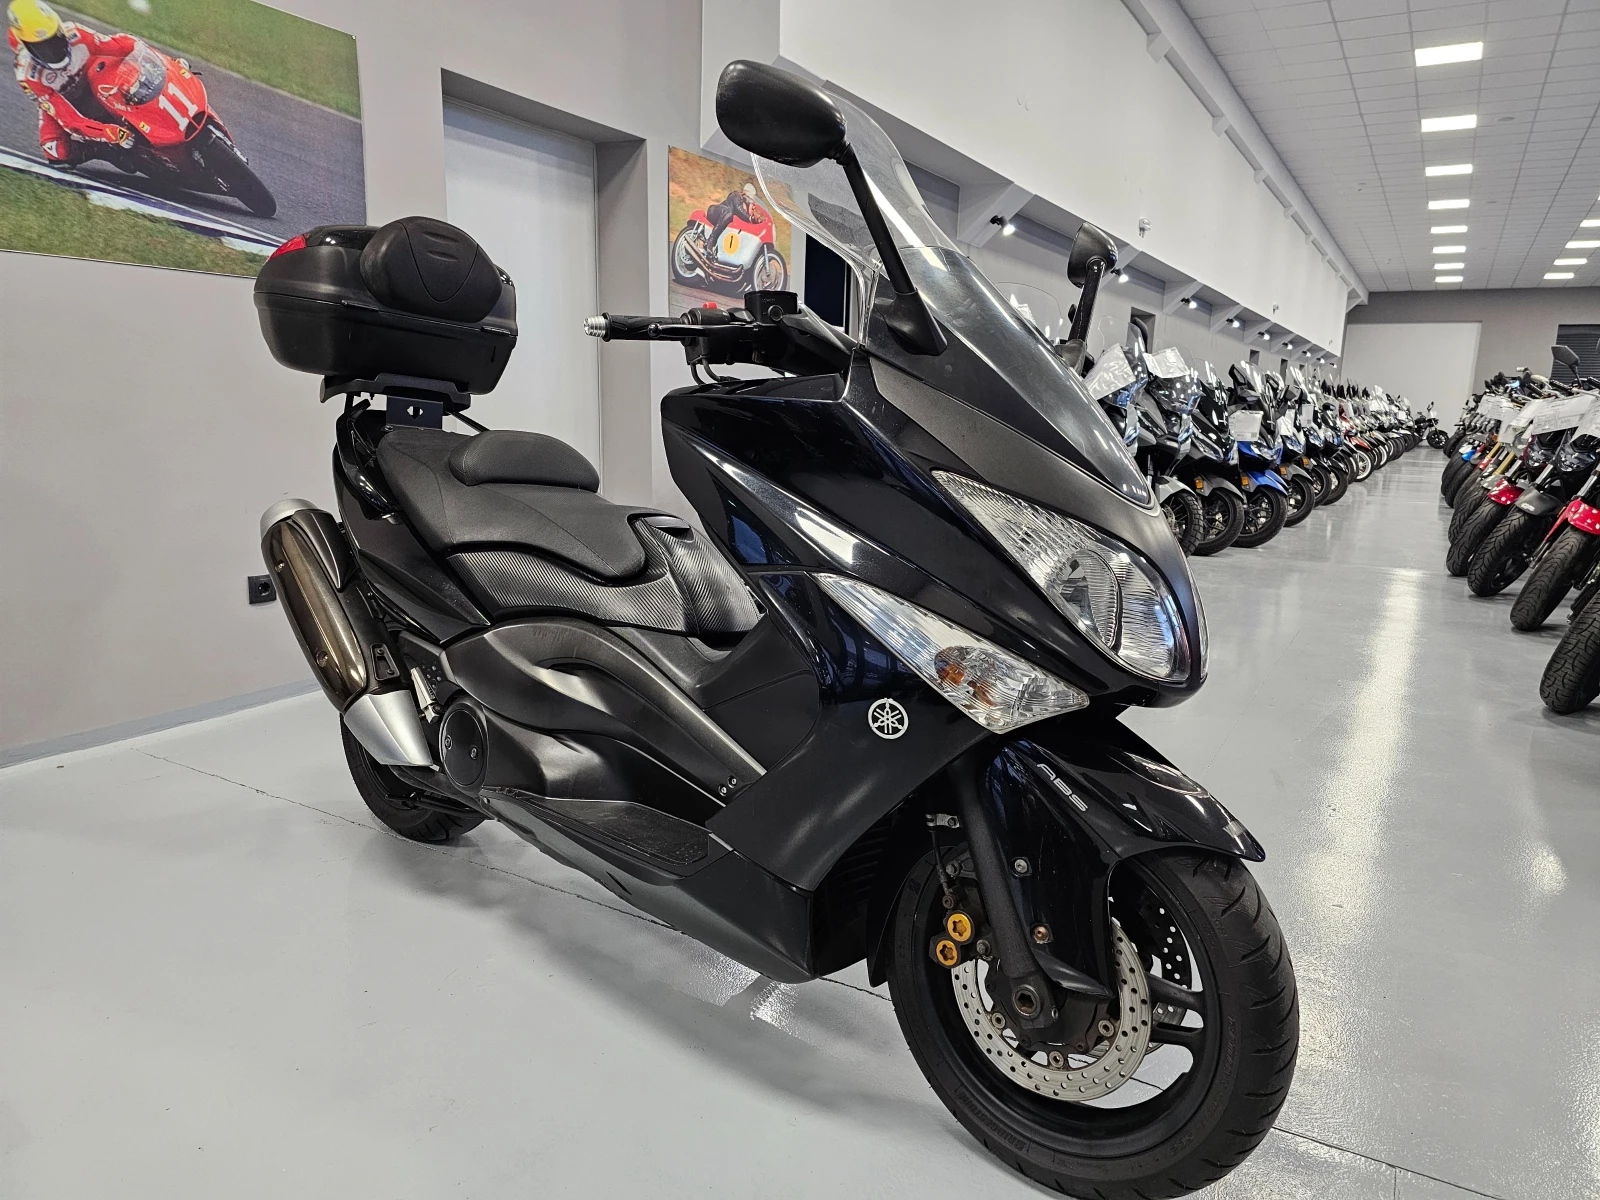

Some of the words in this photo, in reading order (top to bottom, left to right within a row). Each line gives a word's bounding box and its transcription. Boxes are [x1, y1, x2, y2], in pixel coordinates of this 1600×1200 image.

[158, 82, 199, 131] 11
[729, 235, 734, 248] 1
[1036, 763, 1089, 812] ABS
